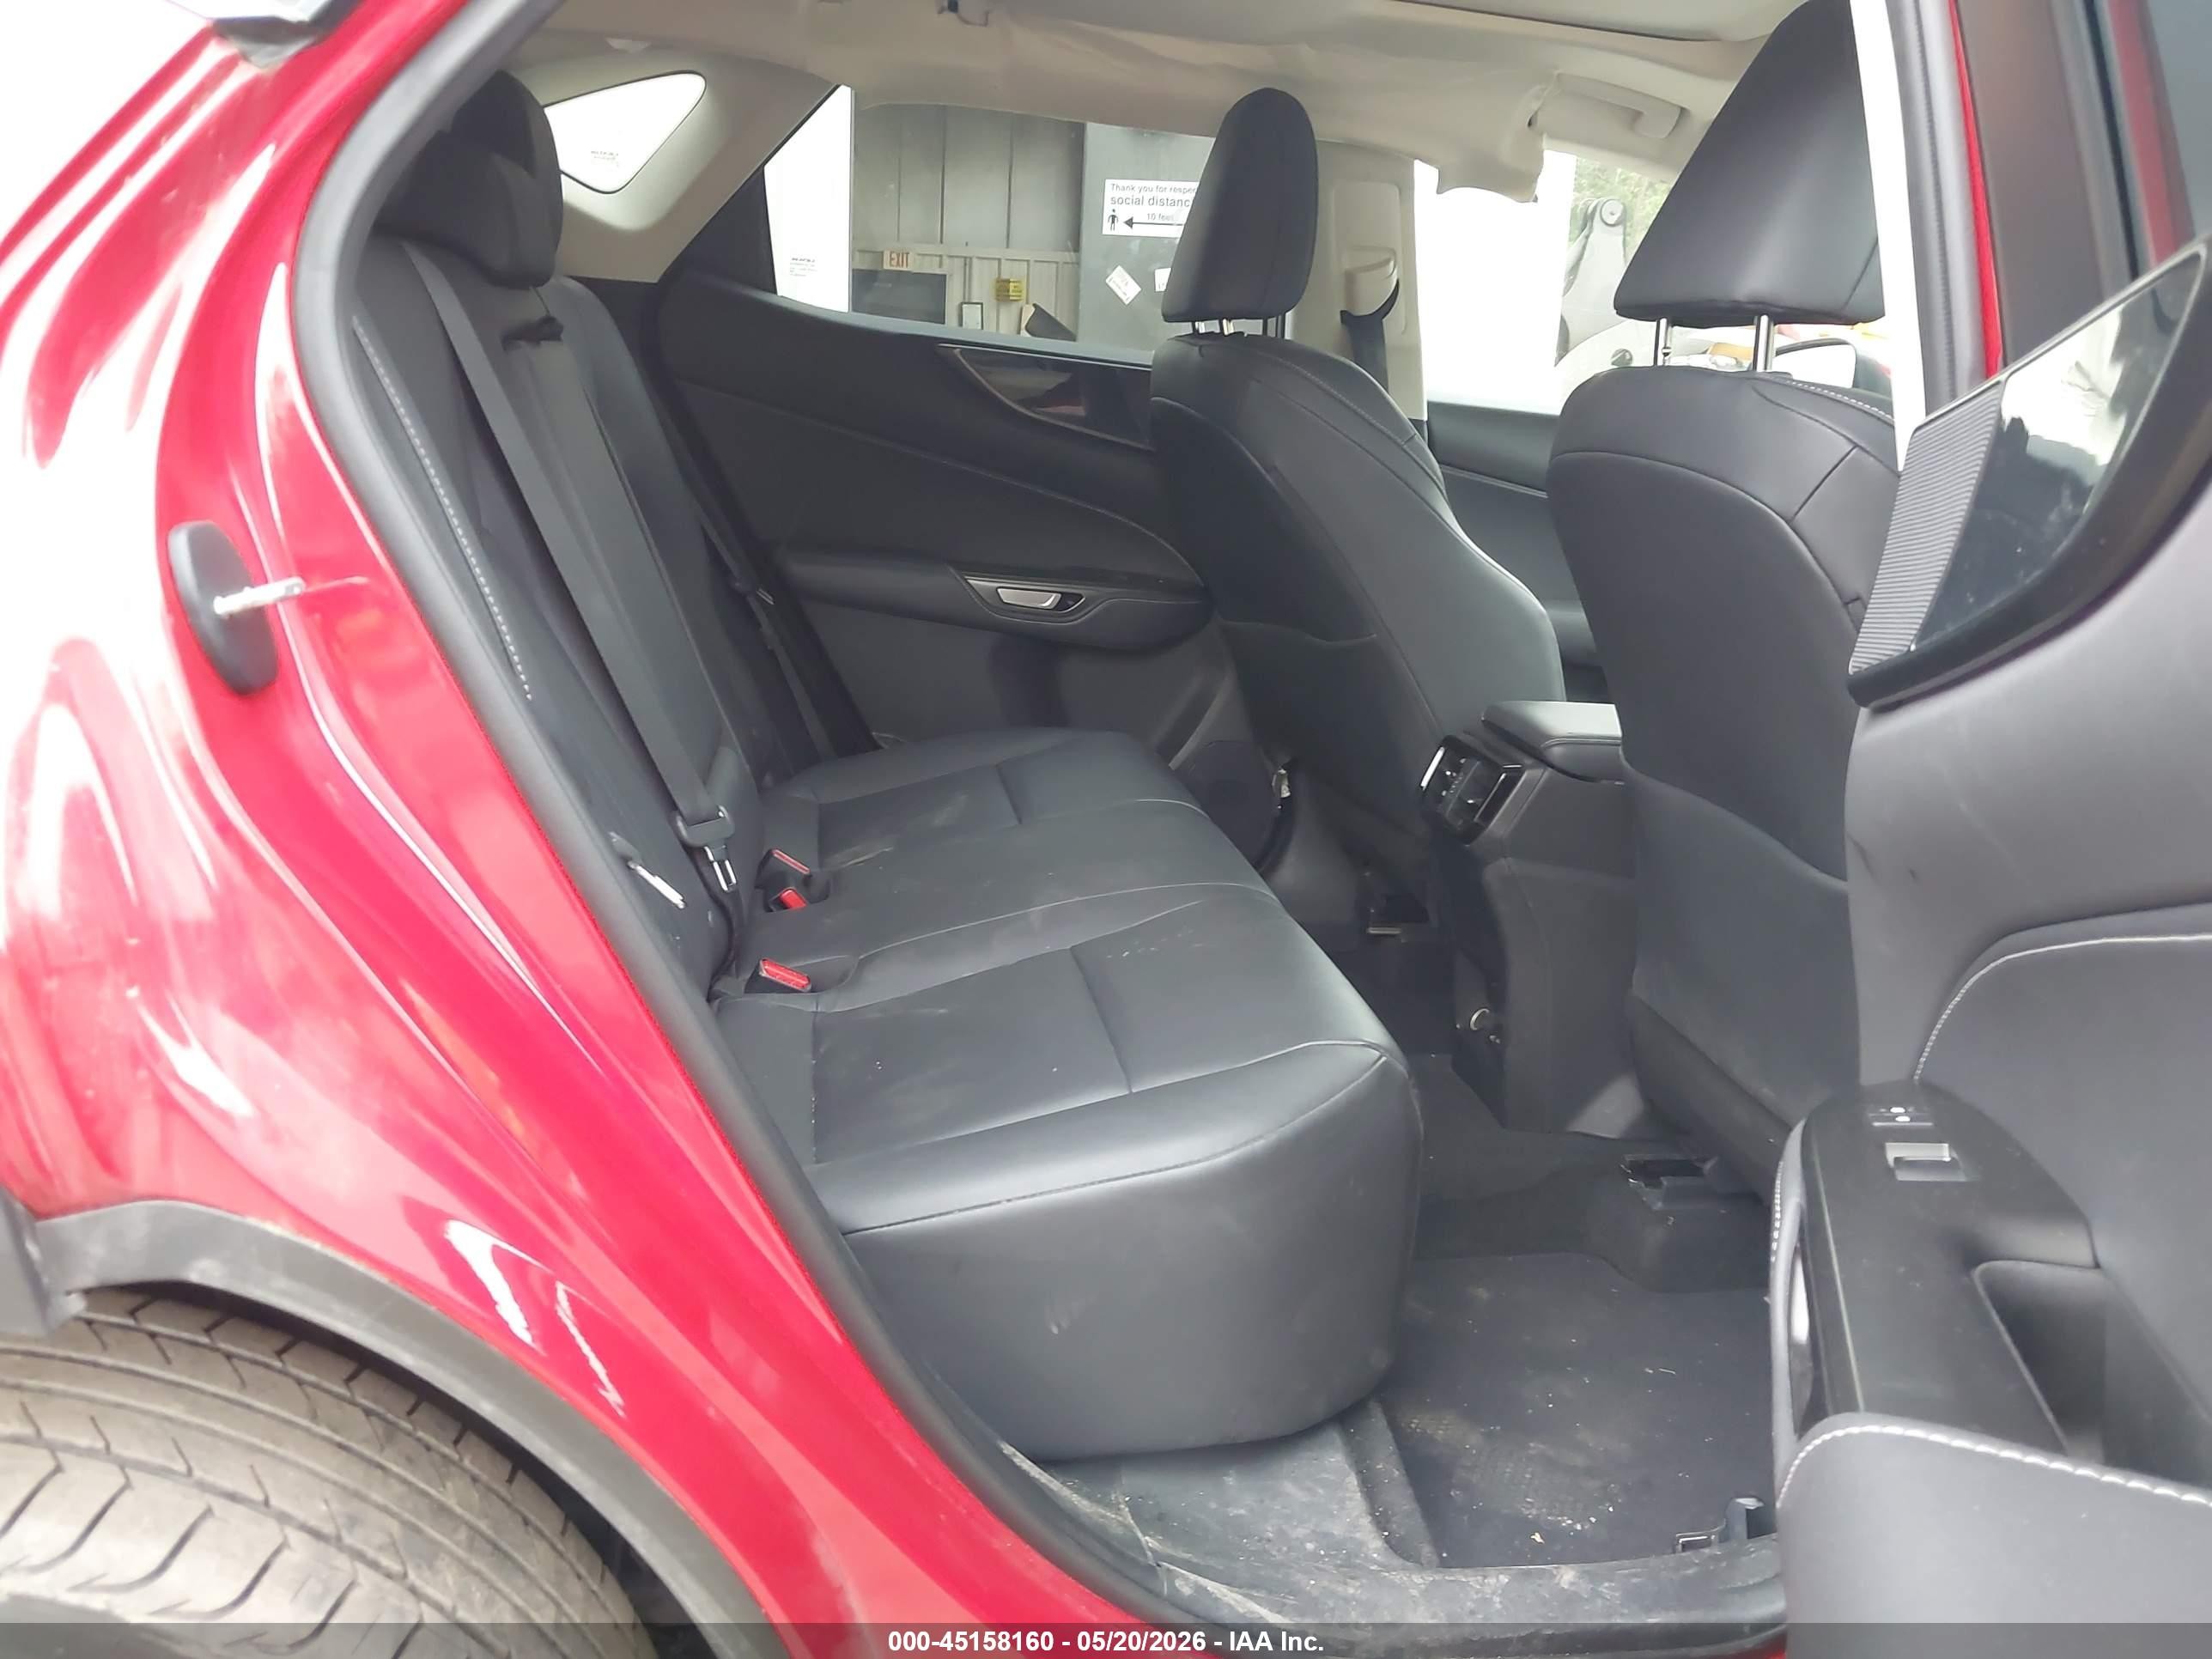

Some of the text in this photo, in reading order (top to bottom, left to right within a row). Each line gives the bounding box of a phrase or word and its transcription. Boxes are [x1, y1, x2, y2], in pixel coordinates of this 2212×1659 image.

[1111, 184, 1135, 192] Thank
[1139, 185, 1154, 194] you
[1110, 195, 1145, 206] social
[1146, 212, 1156, 221] 10
[890, 251, 910, 269] EXIT
